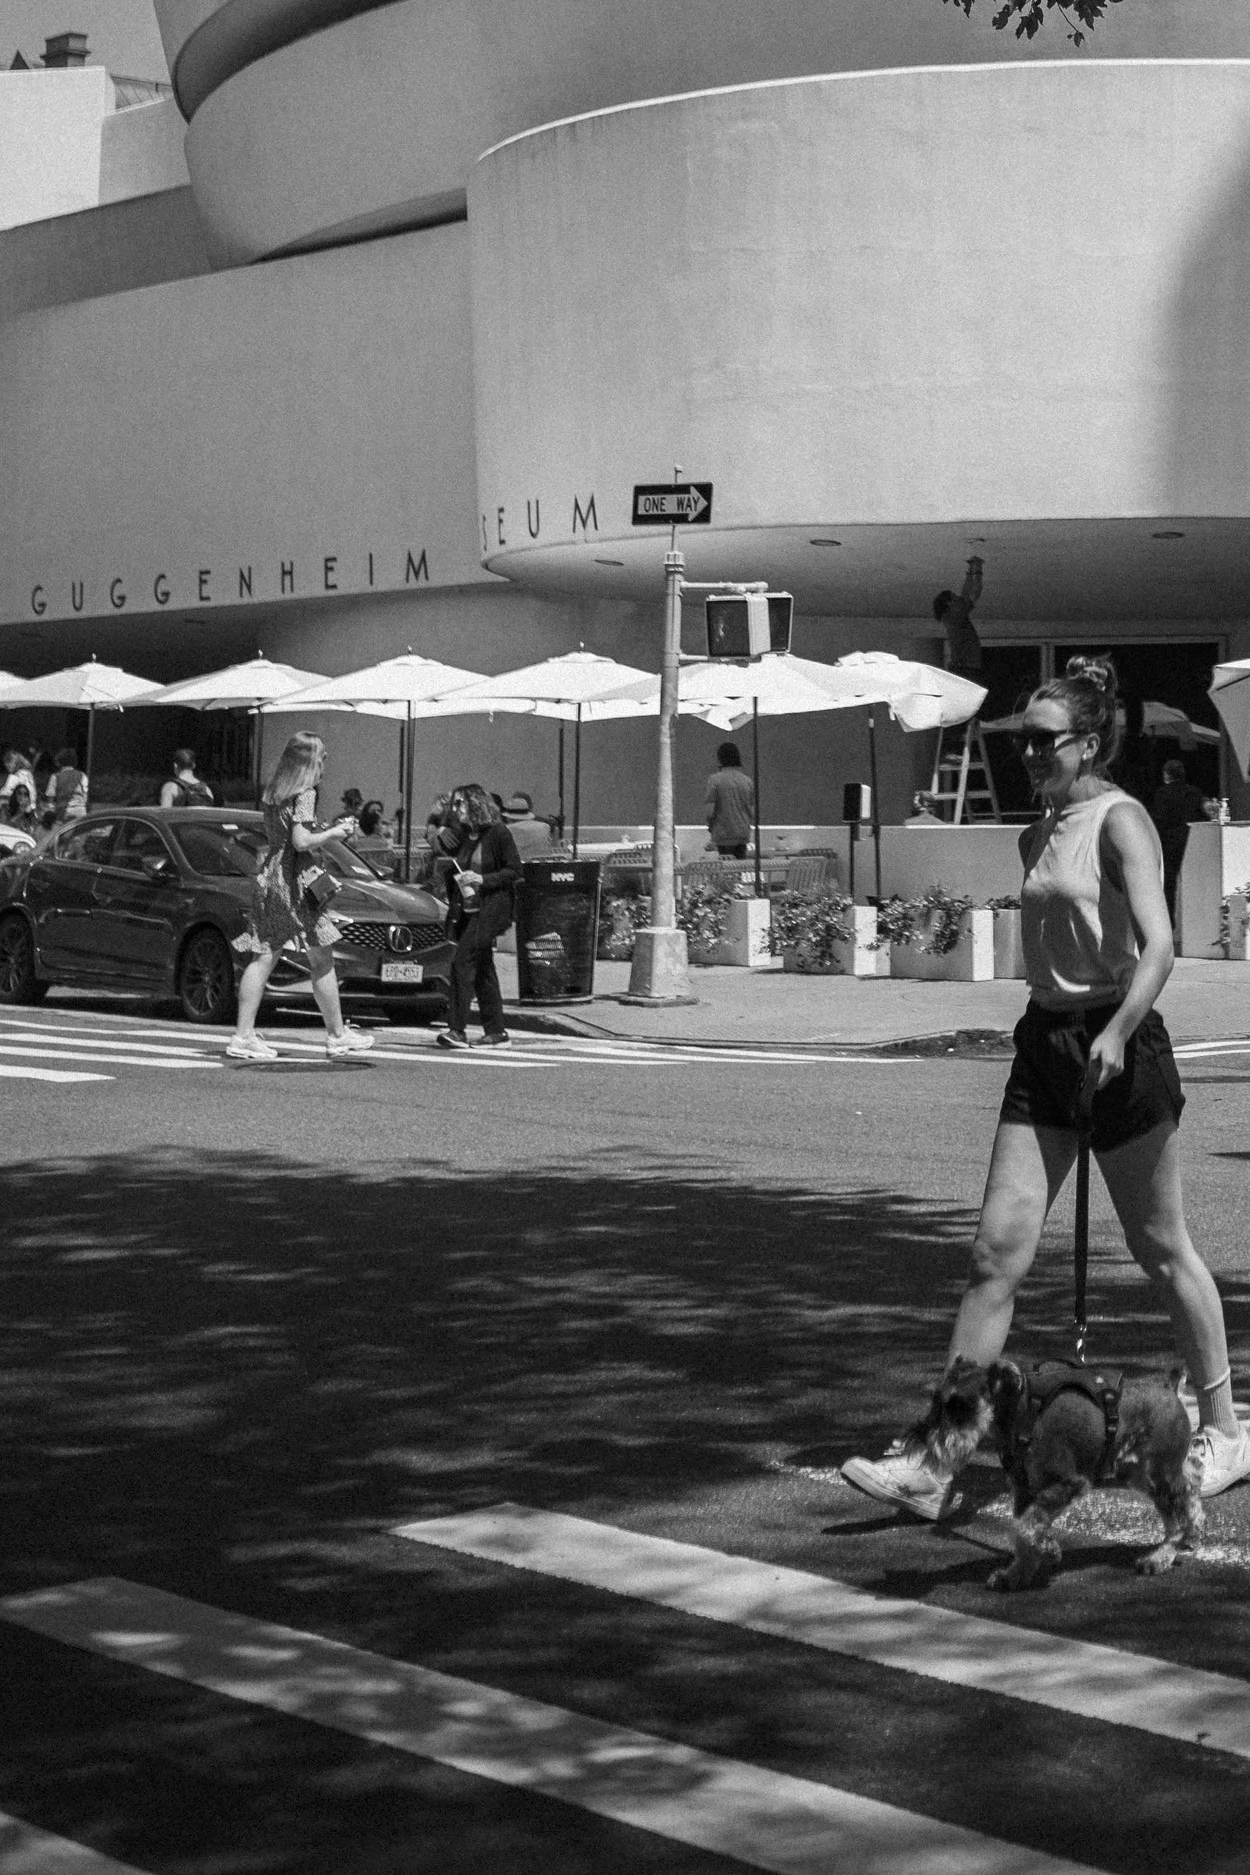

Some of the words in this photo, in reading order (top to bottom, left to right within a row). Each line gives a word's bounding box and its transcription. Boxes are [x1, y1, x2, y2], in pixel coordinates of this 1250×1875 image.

[643, 496, 667, 513] ONE
[676, 495, 701, 513] WAY
[31, 548, 430, 615] GUGGENHEIM
[550, 872, 575, 882] NYC
